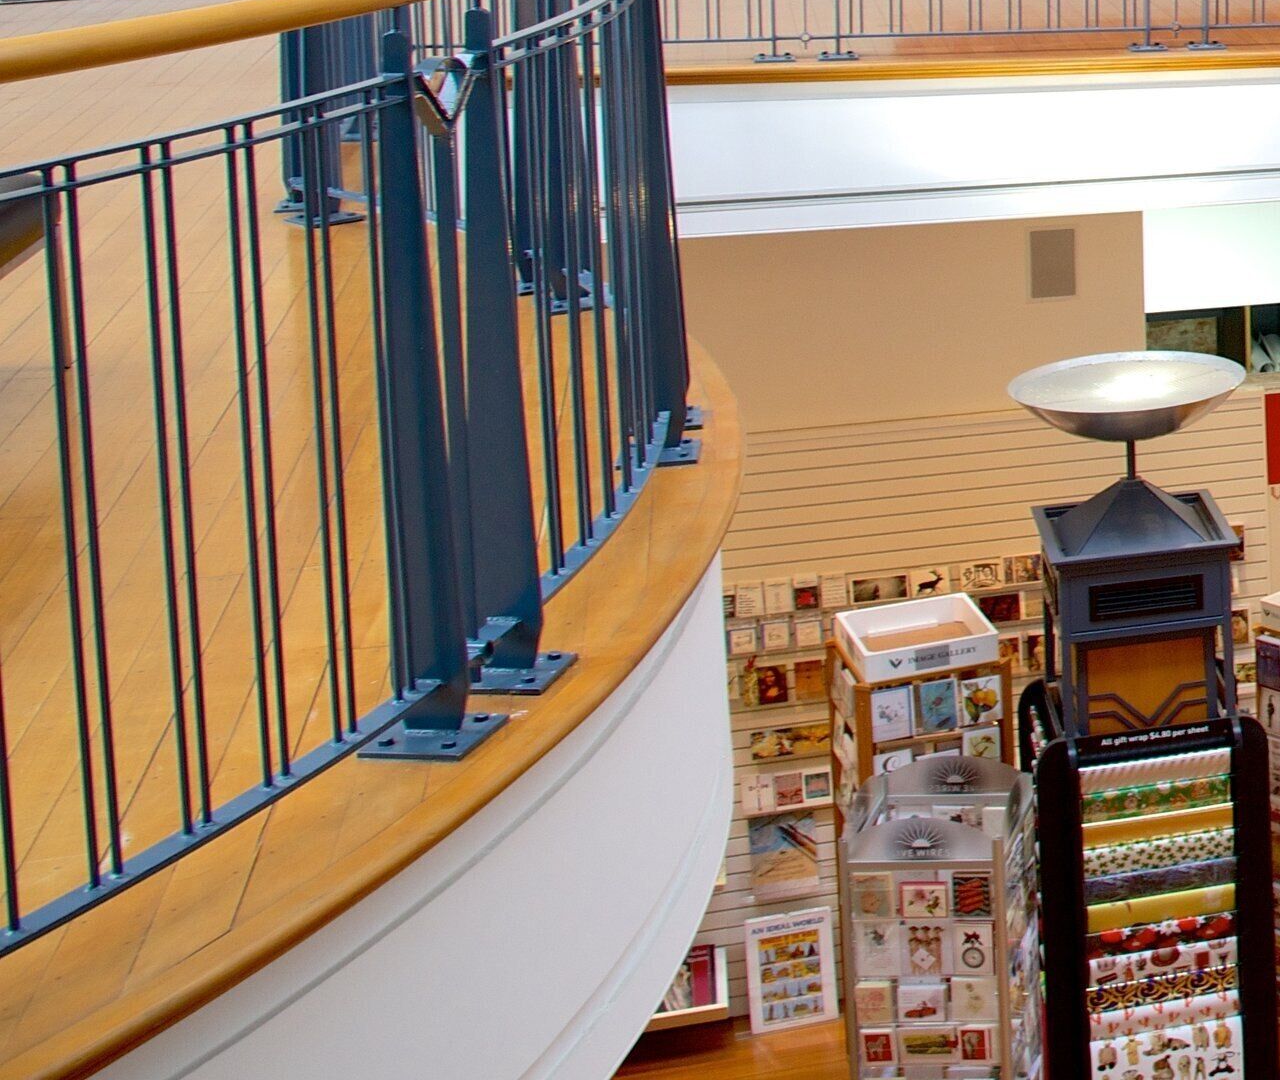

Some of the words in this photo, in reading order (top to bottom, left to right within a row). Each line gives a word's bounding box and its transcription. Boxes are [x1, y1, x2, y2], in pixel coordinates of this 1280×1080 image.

[1101, 738, 1113, 746] All
[1113, 736, 1128, 746] gift
[1128, 734, 1149, 743] wrap
[1172, 730, 1186, 738] per
[1187, 725, 1210, 735] sheet
